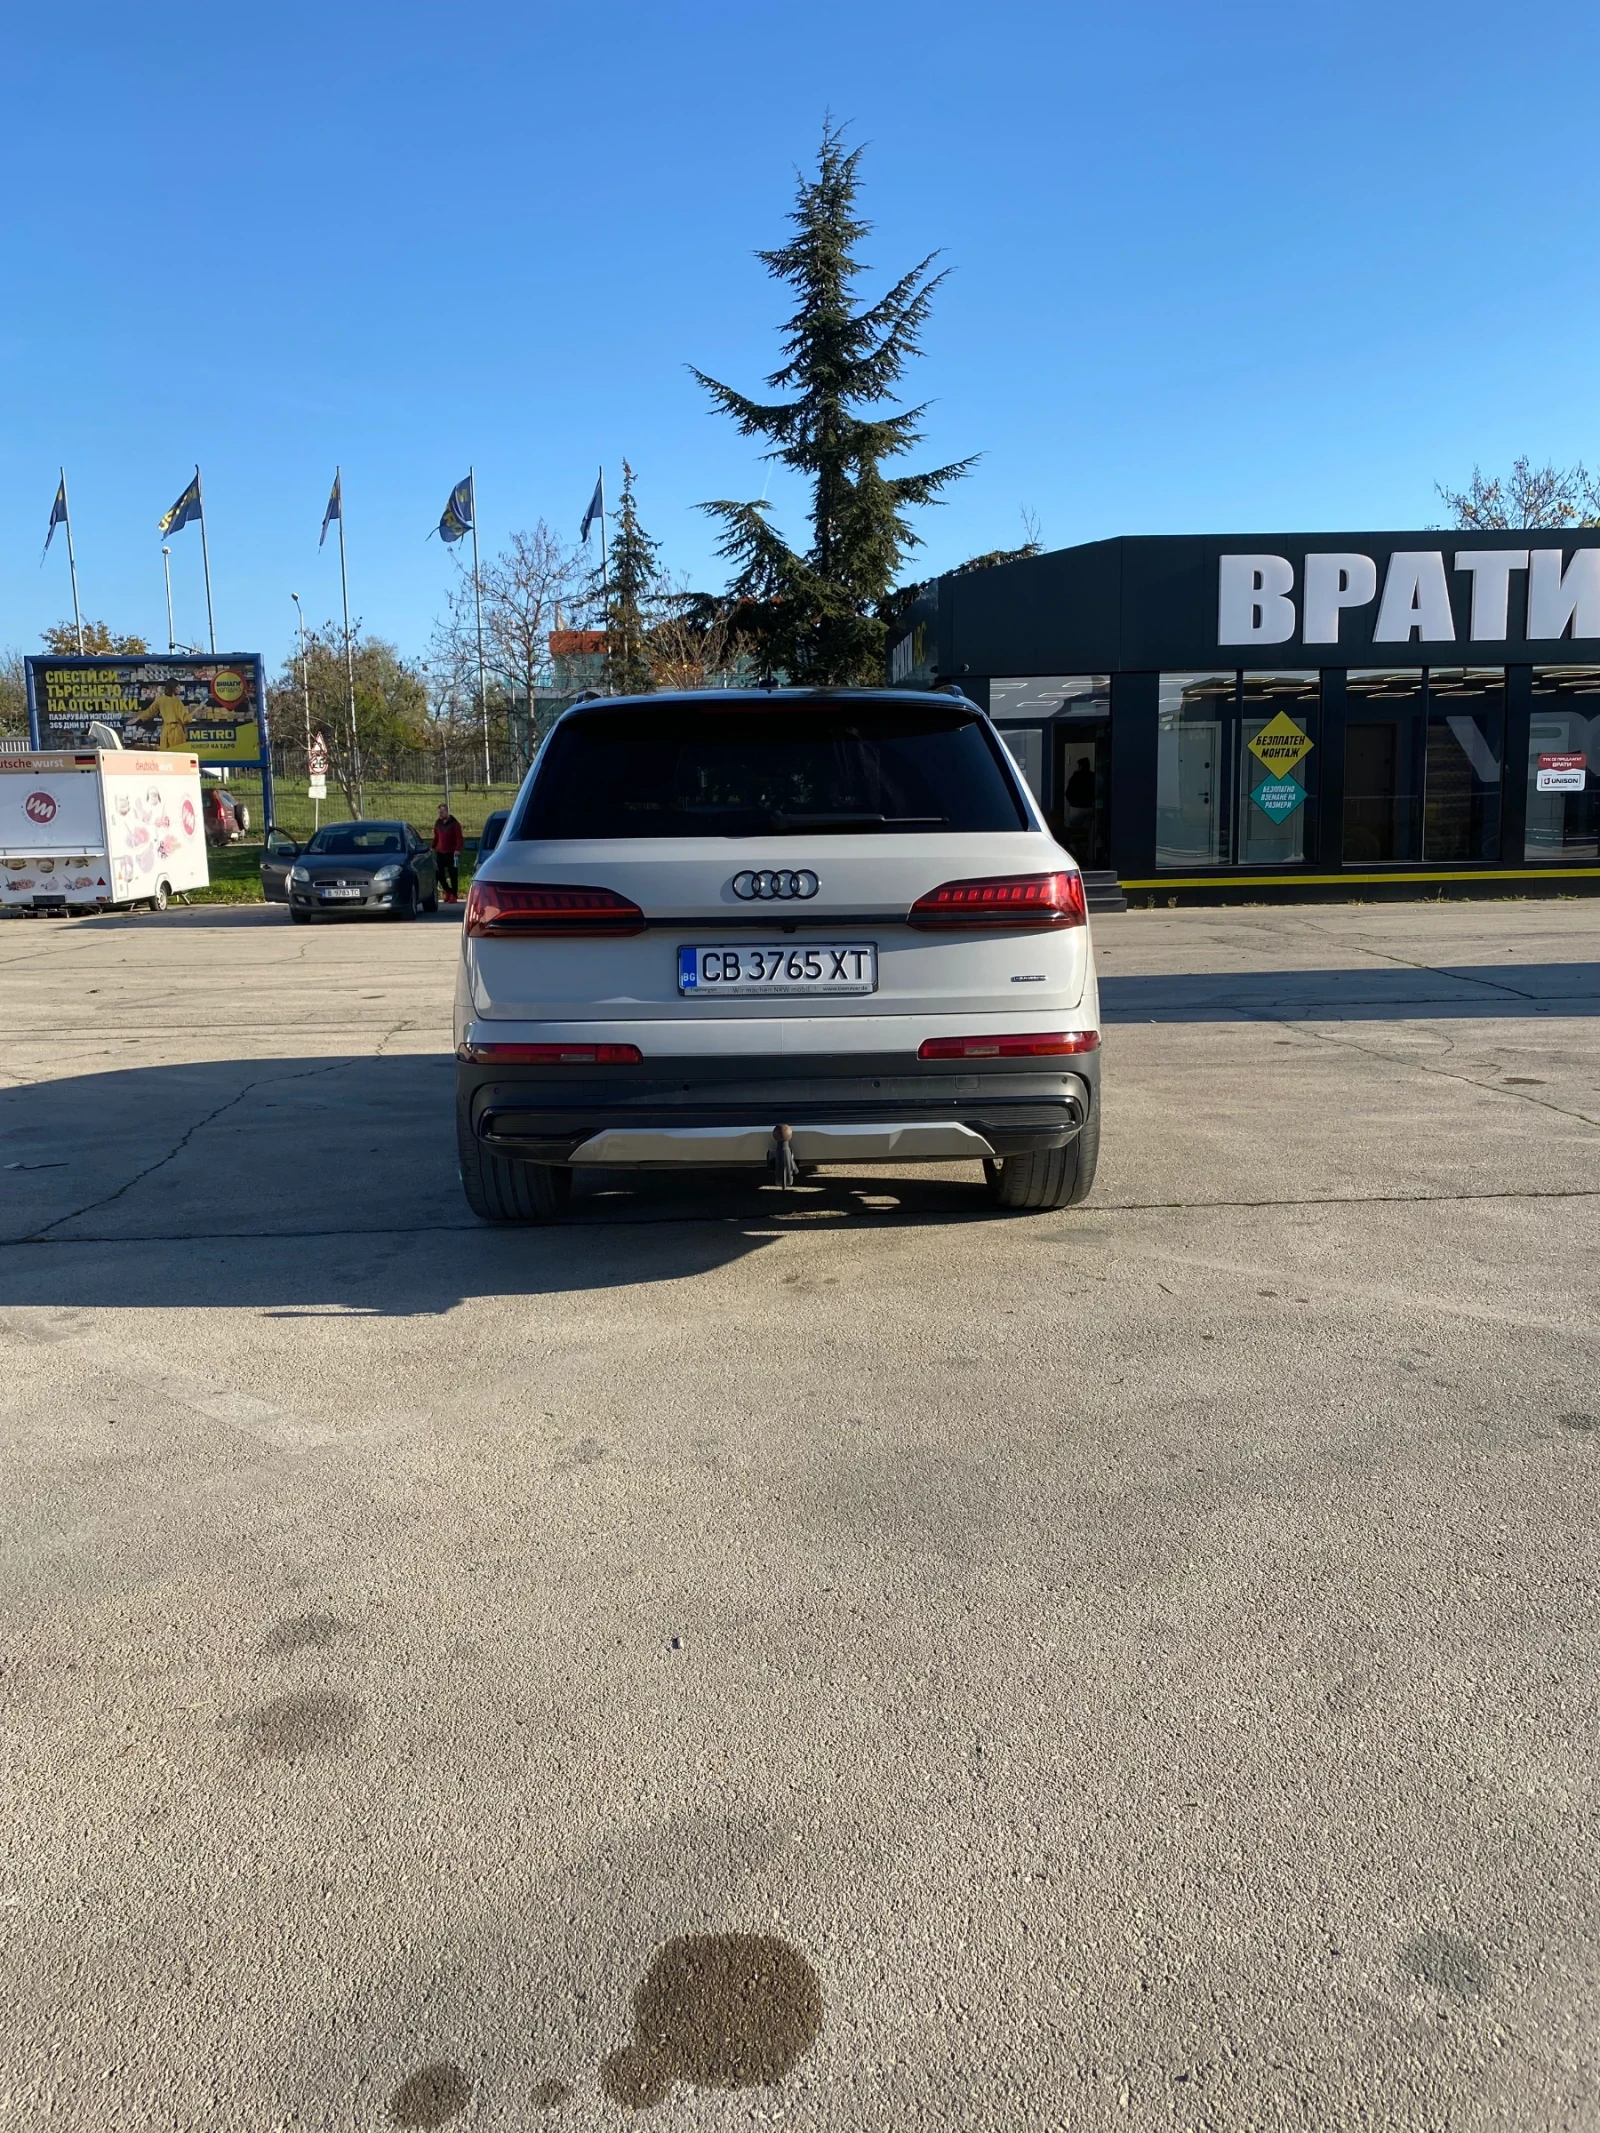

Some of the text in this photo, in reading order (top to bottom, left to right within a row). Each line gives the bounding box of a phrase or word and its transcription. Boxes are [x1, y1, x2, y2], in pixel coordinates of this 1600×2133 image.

[1218, 548, 1600, 646] ВРАТИ
[45, 670, 118, 683] СПЕСТИ СИ
[46, 684, 122, 698] ТЪРСЕНЕТО
[47, 698, 142, 712] НА ОТСТЪПКИ.
[48, 712, 122, 721] ПАЗАРУВАЙ ИЗГОДНО
[49, 721, 62, 729] 365
[63, 721, 79, 730] ДНИ
[80, 721, 85, 729] В
[189, 729, 235, 740] METRO
[1256, 735, 1306, 746] БЕЗПЛАТЕН
[1261, 747, 1300, 758] МОНТАЖ
[1262, 785, 1295, 793] БЕЗПЛАТНО
[1260, 793, 1296, 801] ВЗЕМАНЕ НА
[1264, 801, 1292, 809] РАЗМЕРИ
[702, 950, 869, 981] CB 3765 XT
[683, 972, 696, 982] BG
